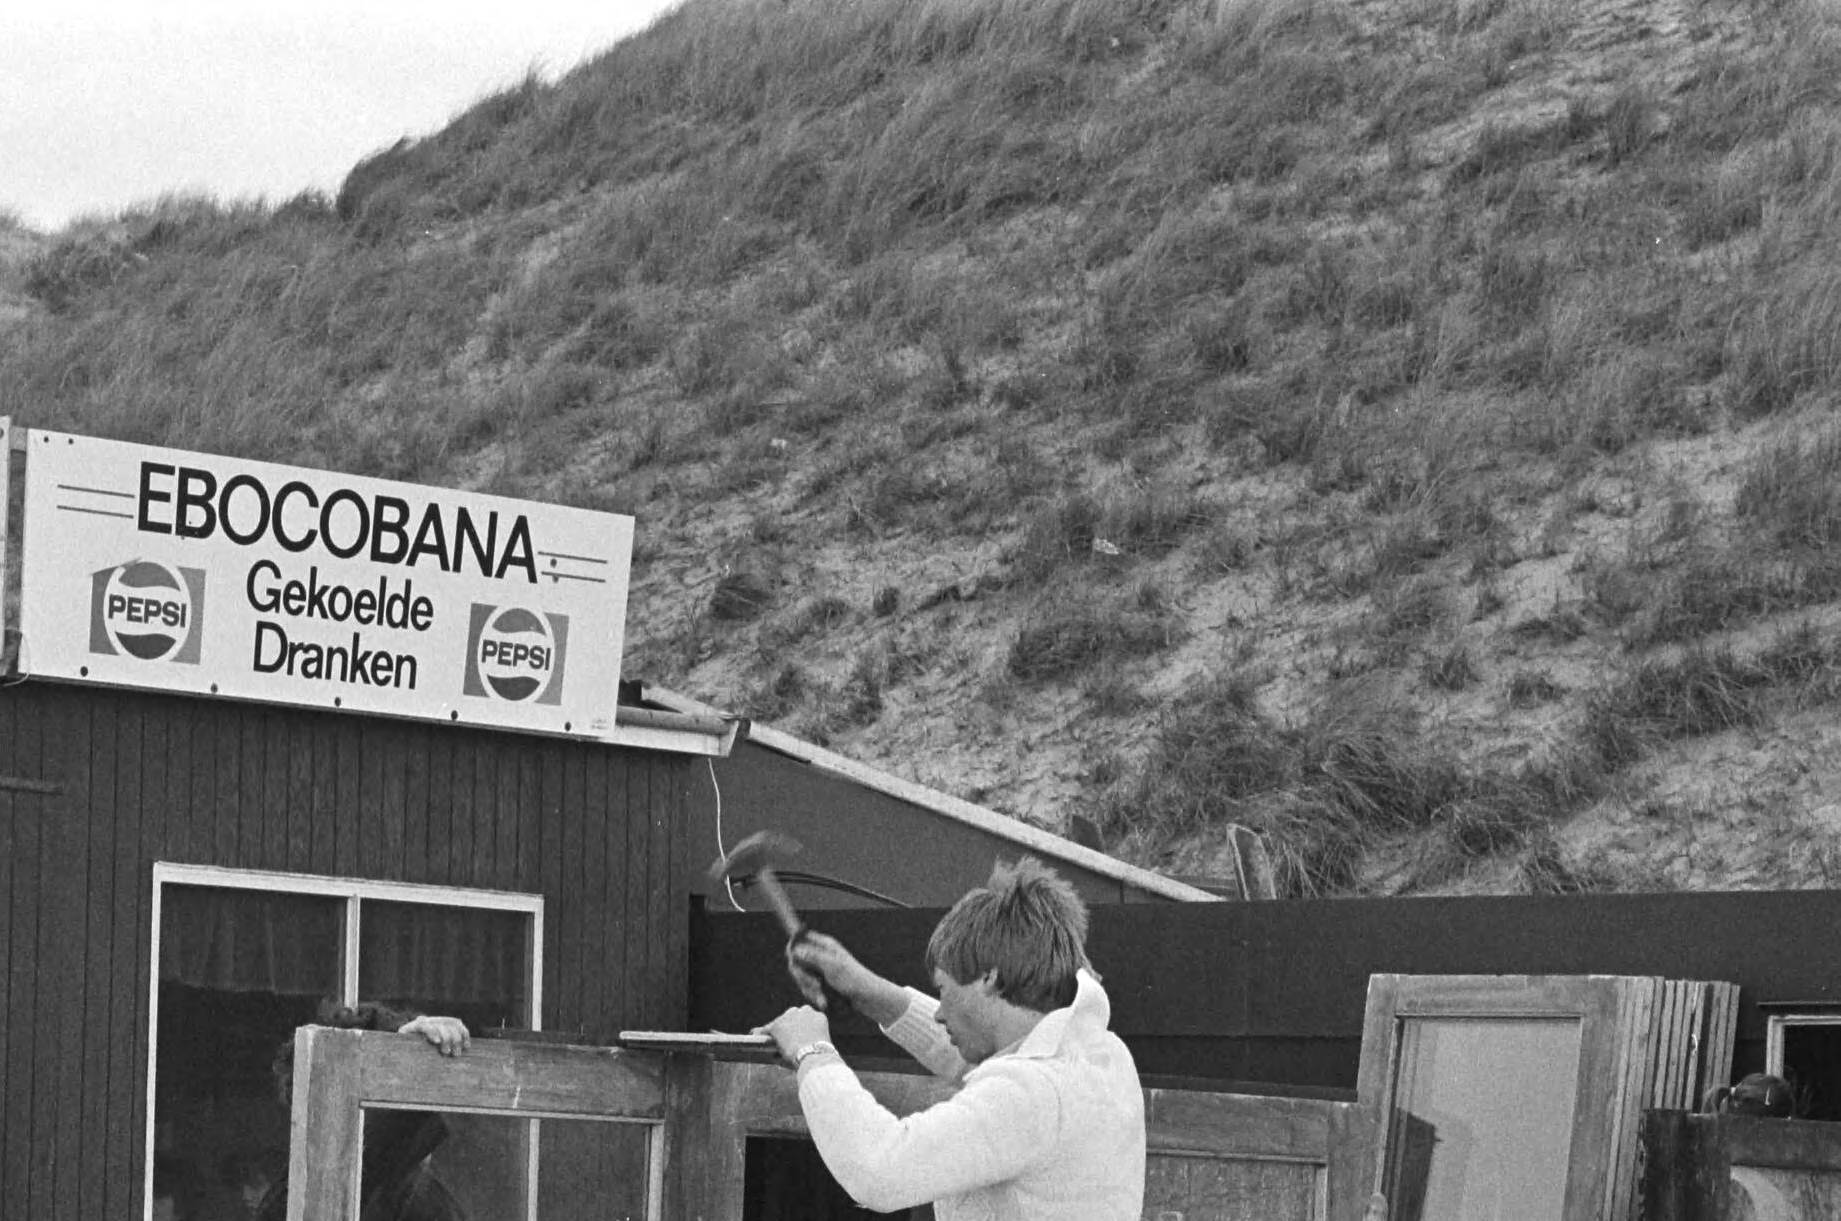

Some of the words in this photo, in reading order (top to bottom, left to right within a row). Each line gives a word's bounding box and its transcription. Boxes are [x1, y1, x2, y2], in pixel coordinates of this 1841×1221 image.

[138, 460, 538, 584] EBOCOBANA
[108, 593, 188, 629] PEPSI
[246, 559, 434, 632] Gekoelde
[253, 620, 417, 690] Dranken
[481, 638, 552, 671] PEPSI
